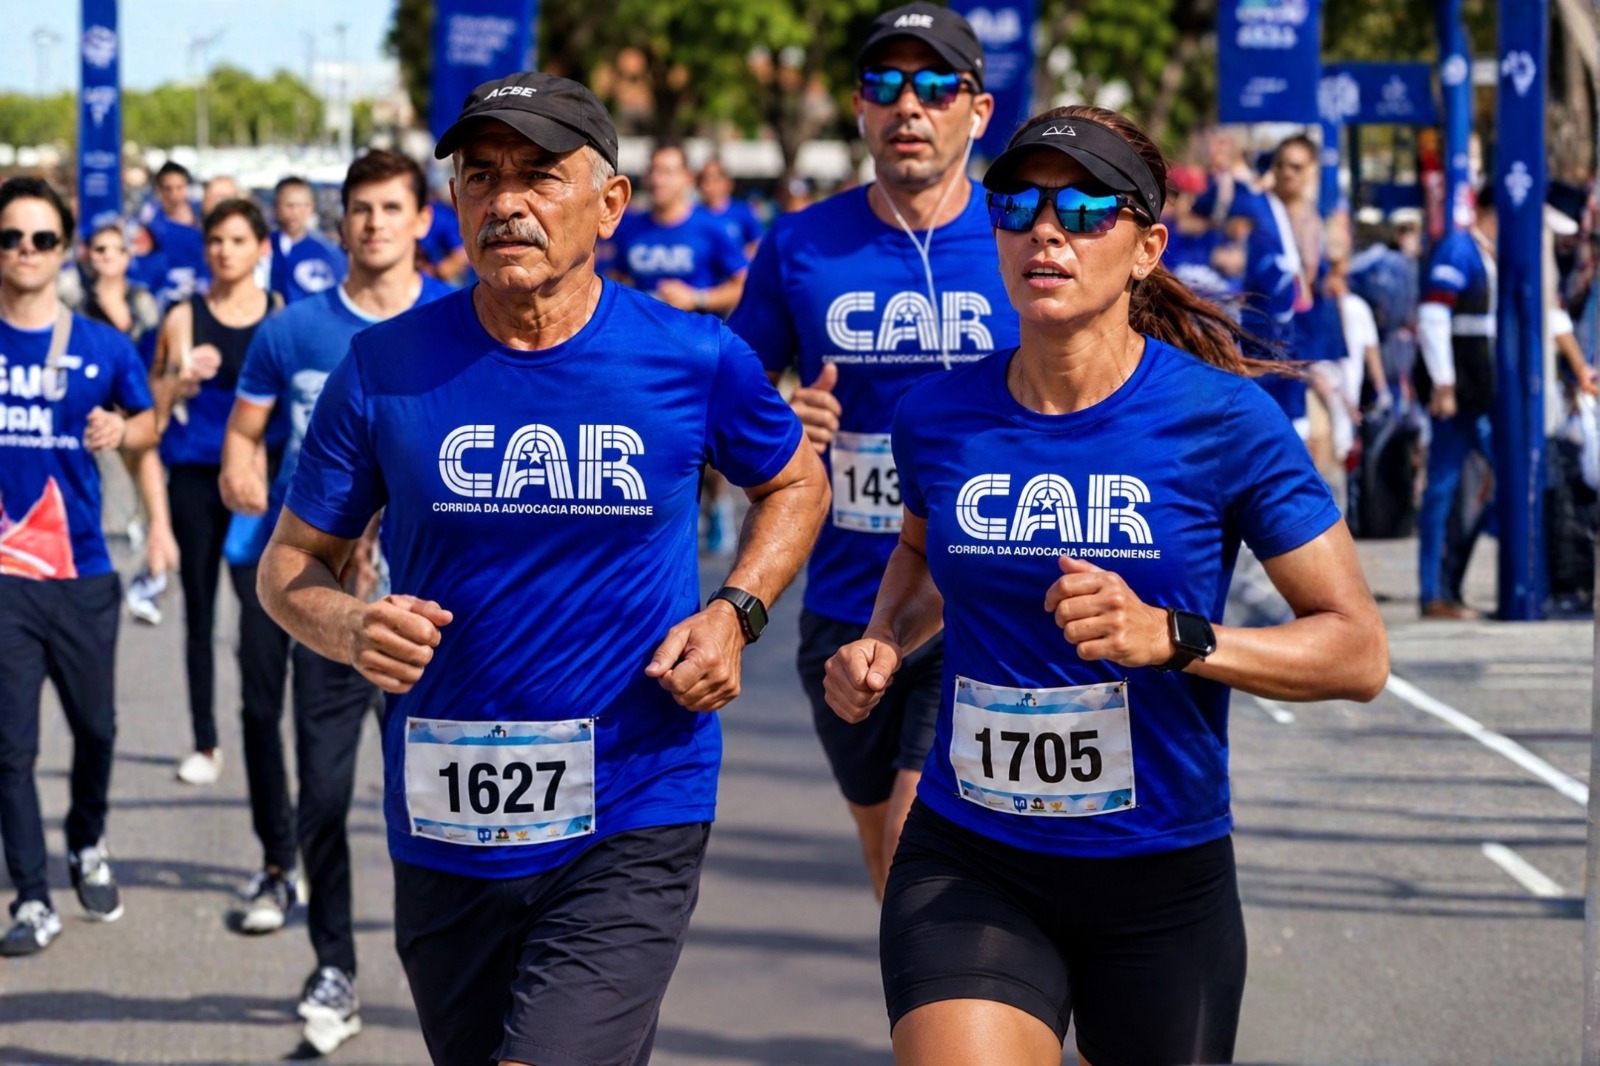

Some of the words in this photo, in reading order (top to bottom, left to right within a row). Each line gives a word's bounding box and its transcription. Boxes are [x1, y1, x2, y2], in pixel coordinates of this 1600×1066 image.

[483, 86, 538, 101] ACBE
[825, 291, 994, 351] CAR
[865, 355, 878, 364] DA
[880, 354, 935, 364] ADVOCACIA
[438, 423, 647, 500] CAR
[432, 502, 482, 513] CORRIDA
[484, 503, 500, 513] DA
[501, 503, 569, 514] ADVOCACIA
[570, 504, 654, 516] RONDONIENSE
[955, 473, 1153, 545] CAR
[947, 545, 995, 555] CORRIDA
[997, 546, 1012, 555] DA
[1013, 546, 1078, 557] ADVOCACIA
[1080, 548, 1161, 559] RONDONIENSE
[975, 727, 1102, 783] 1705
[439, 760, 566, 814] 1627
